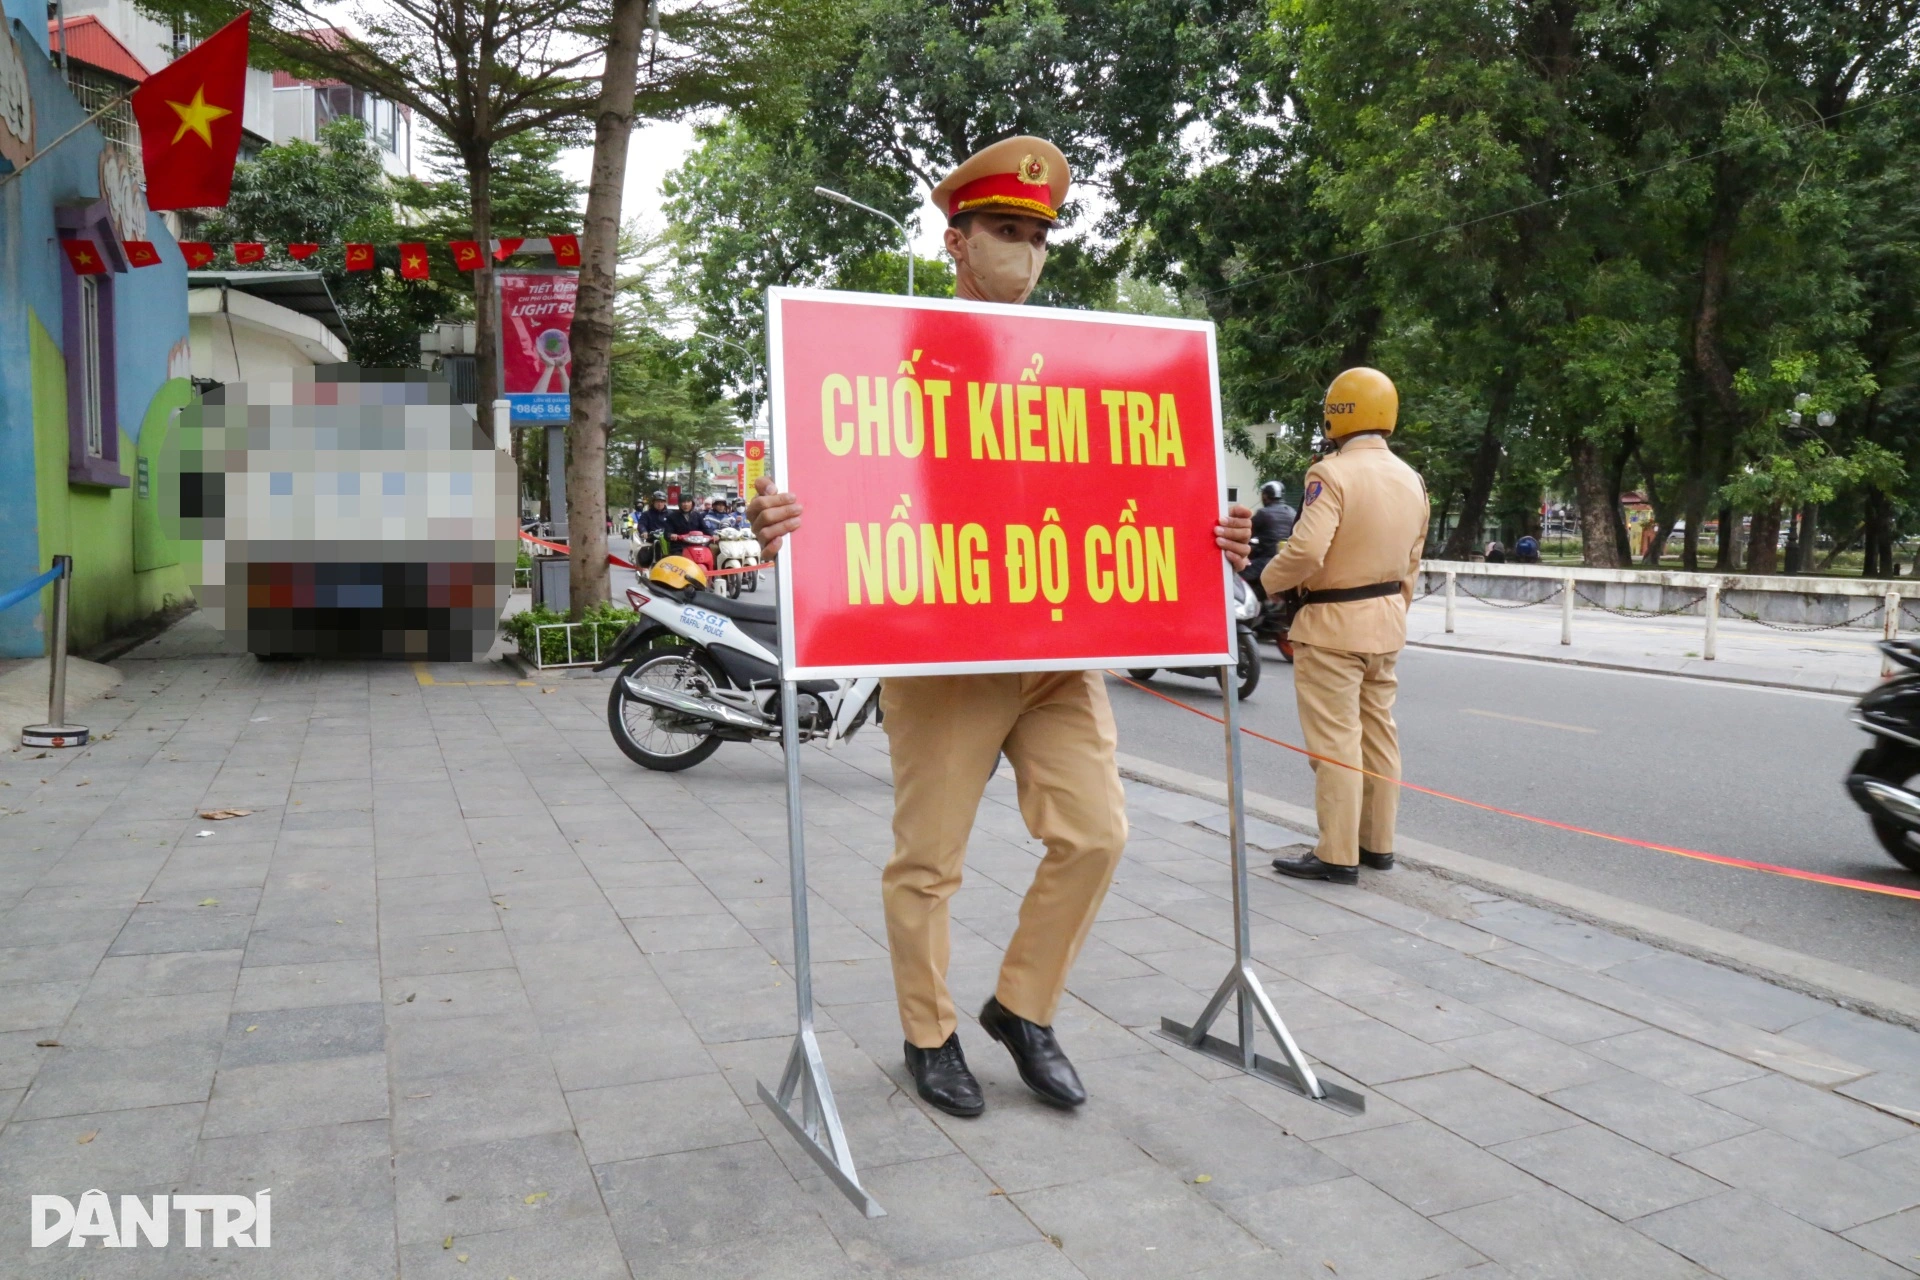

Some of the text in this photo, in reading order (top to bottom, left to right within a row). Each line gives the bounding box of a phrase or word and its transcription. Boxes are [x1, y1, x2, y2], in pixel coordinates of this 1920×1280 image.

[529, 282, 552, 294] TIẾT
[511, 303, 557, 317] LIGHT
[516, 404, 544, 413] 0865
[547, 404, 561, 413] 86
[821, 350, 1186, 467] CHỐT KIỂM TRA
[1326, 402, 1356, 415] CSGT
[845, 494, 1179, 621] NỒNG ĐỘ CỒN
[683, 607, 728, 627] C.S.G.T
[702, 624, 724, 638] POLICE
